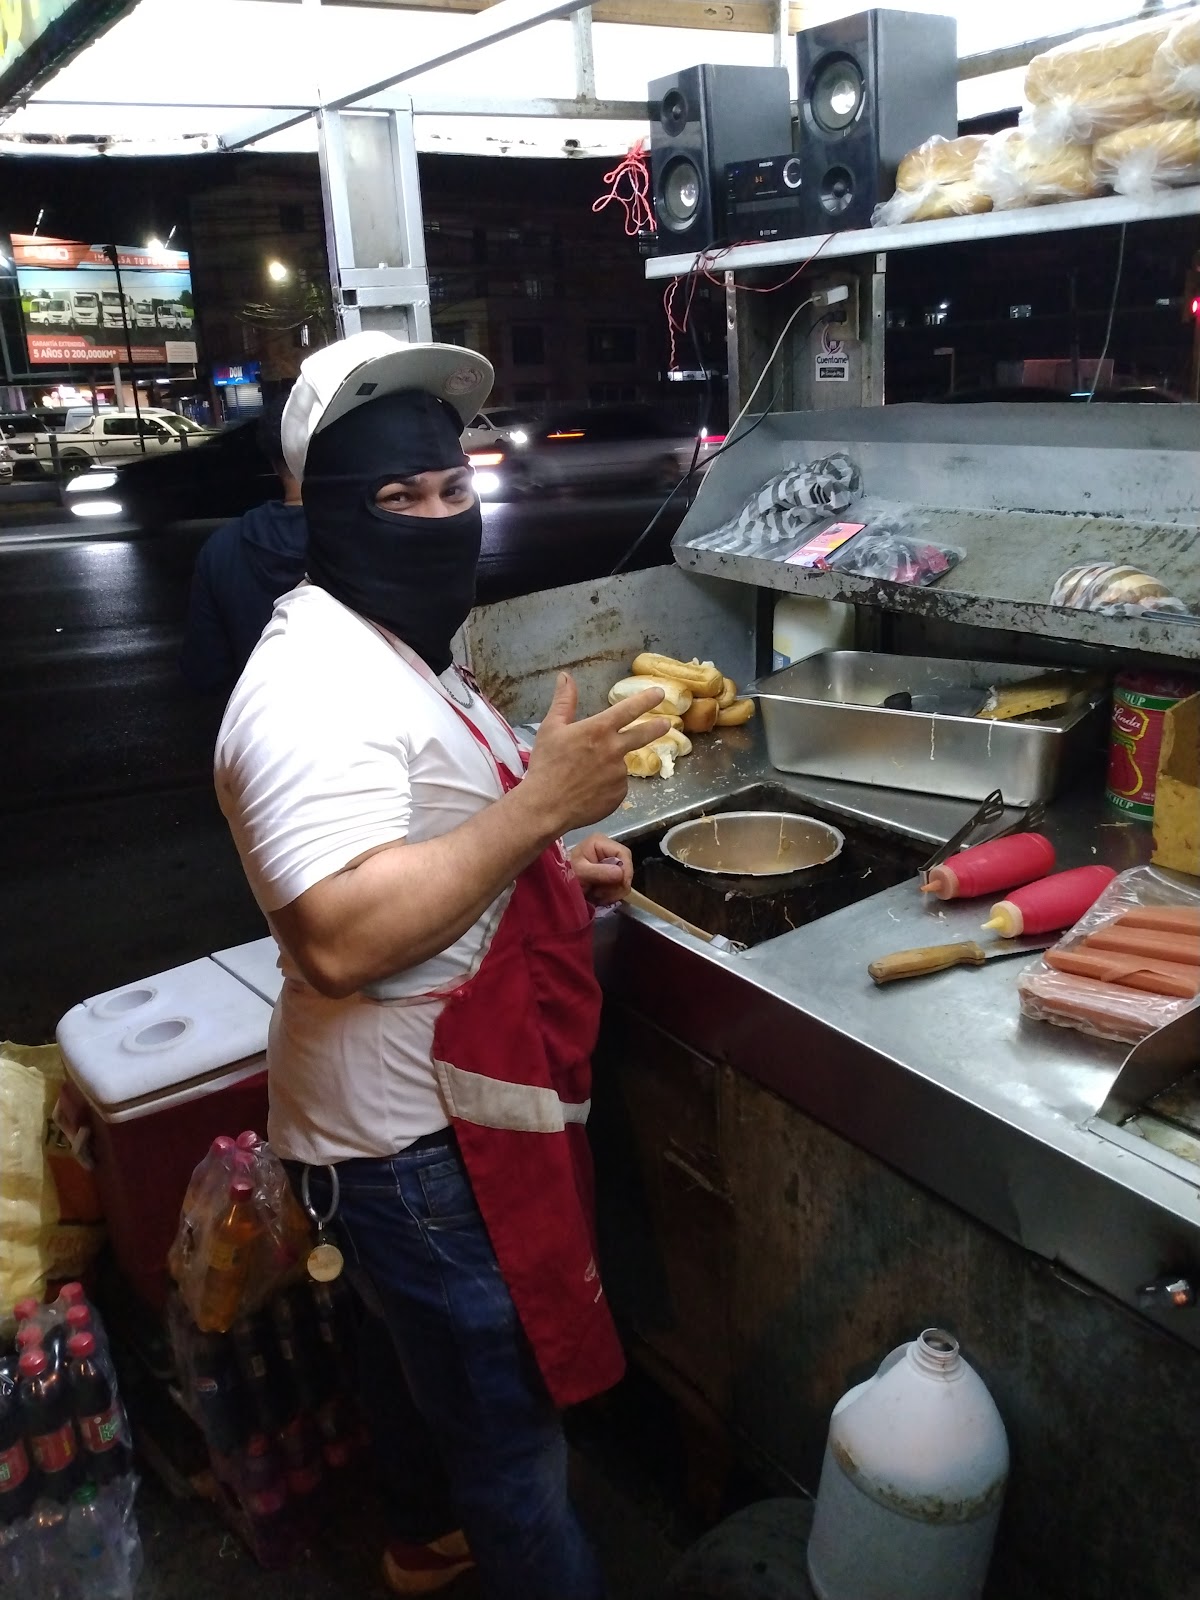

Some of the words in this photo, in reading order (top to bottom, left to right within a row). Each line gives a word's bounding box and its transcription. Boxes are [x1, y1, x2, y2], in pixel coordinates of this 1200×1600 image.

[134, 257, 145, 265] TU
[33, 349, 40, 358] 5
[41, 348, 63, 358] AÑOS
